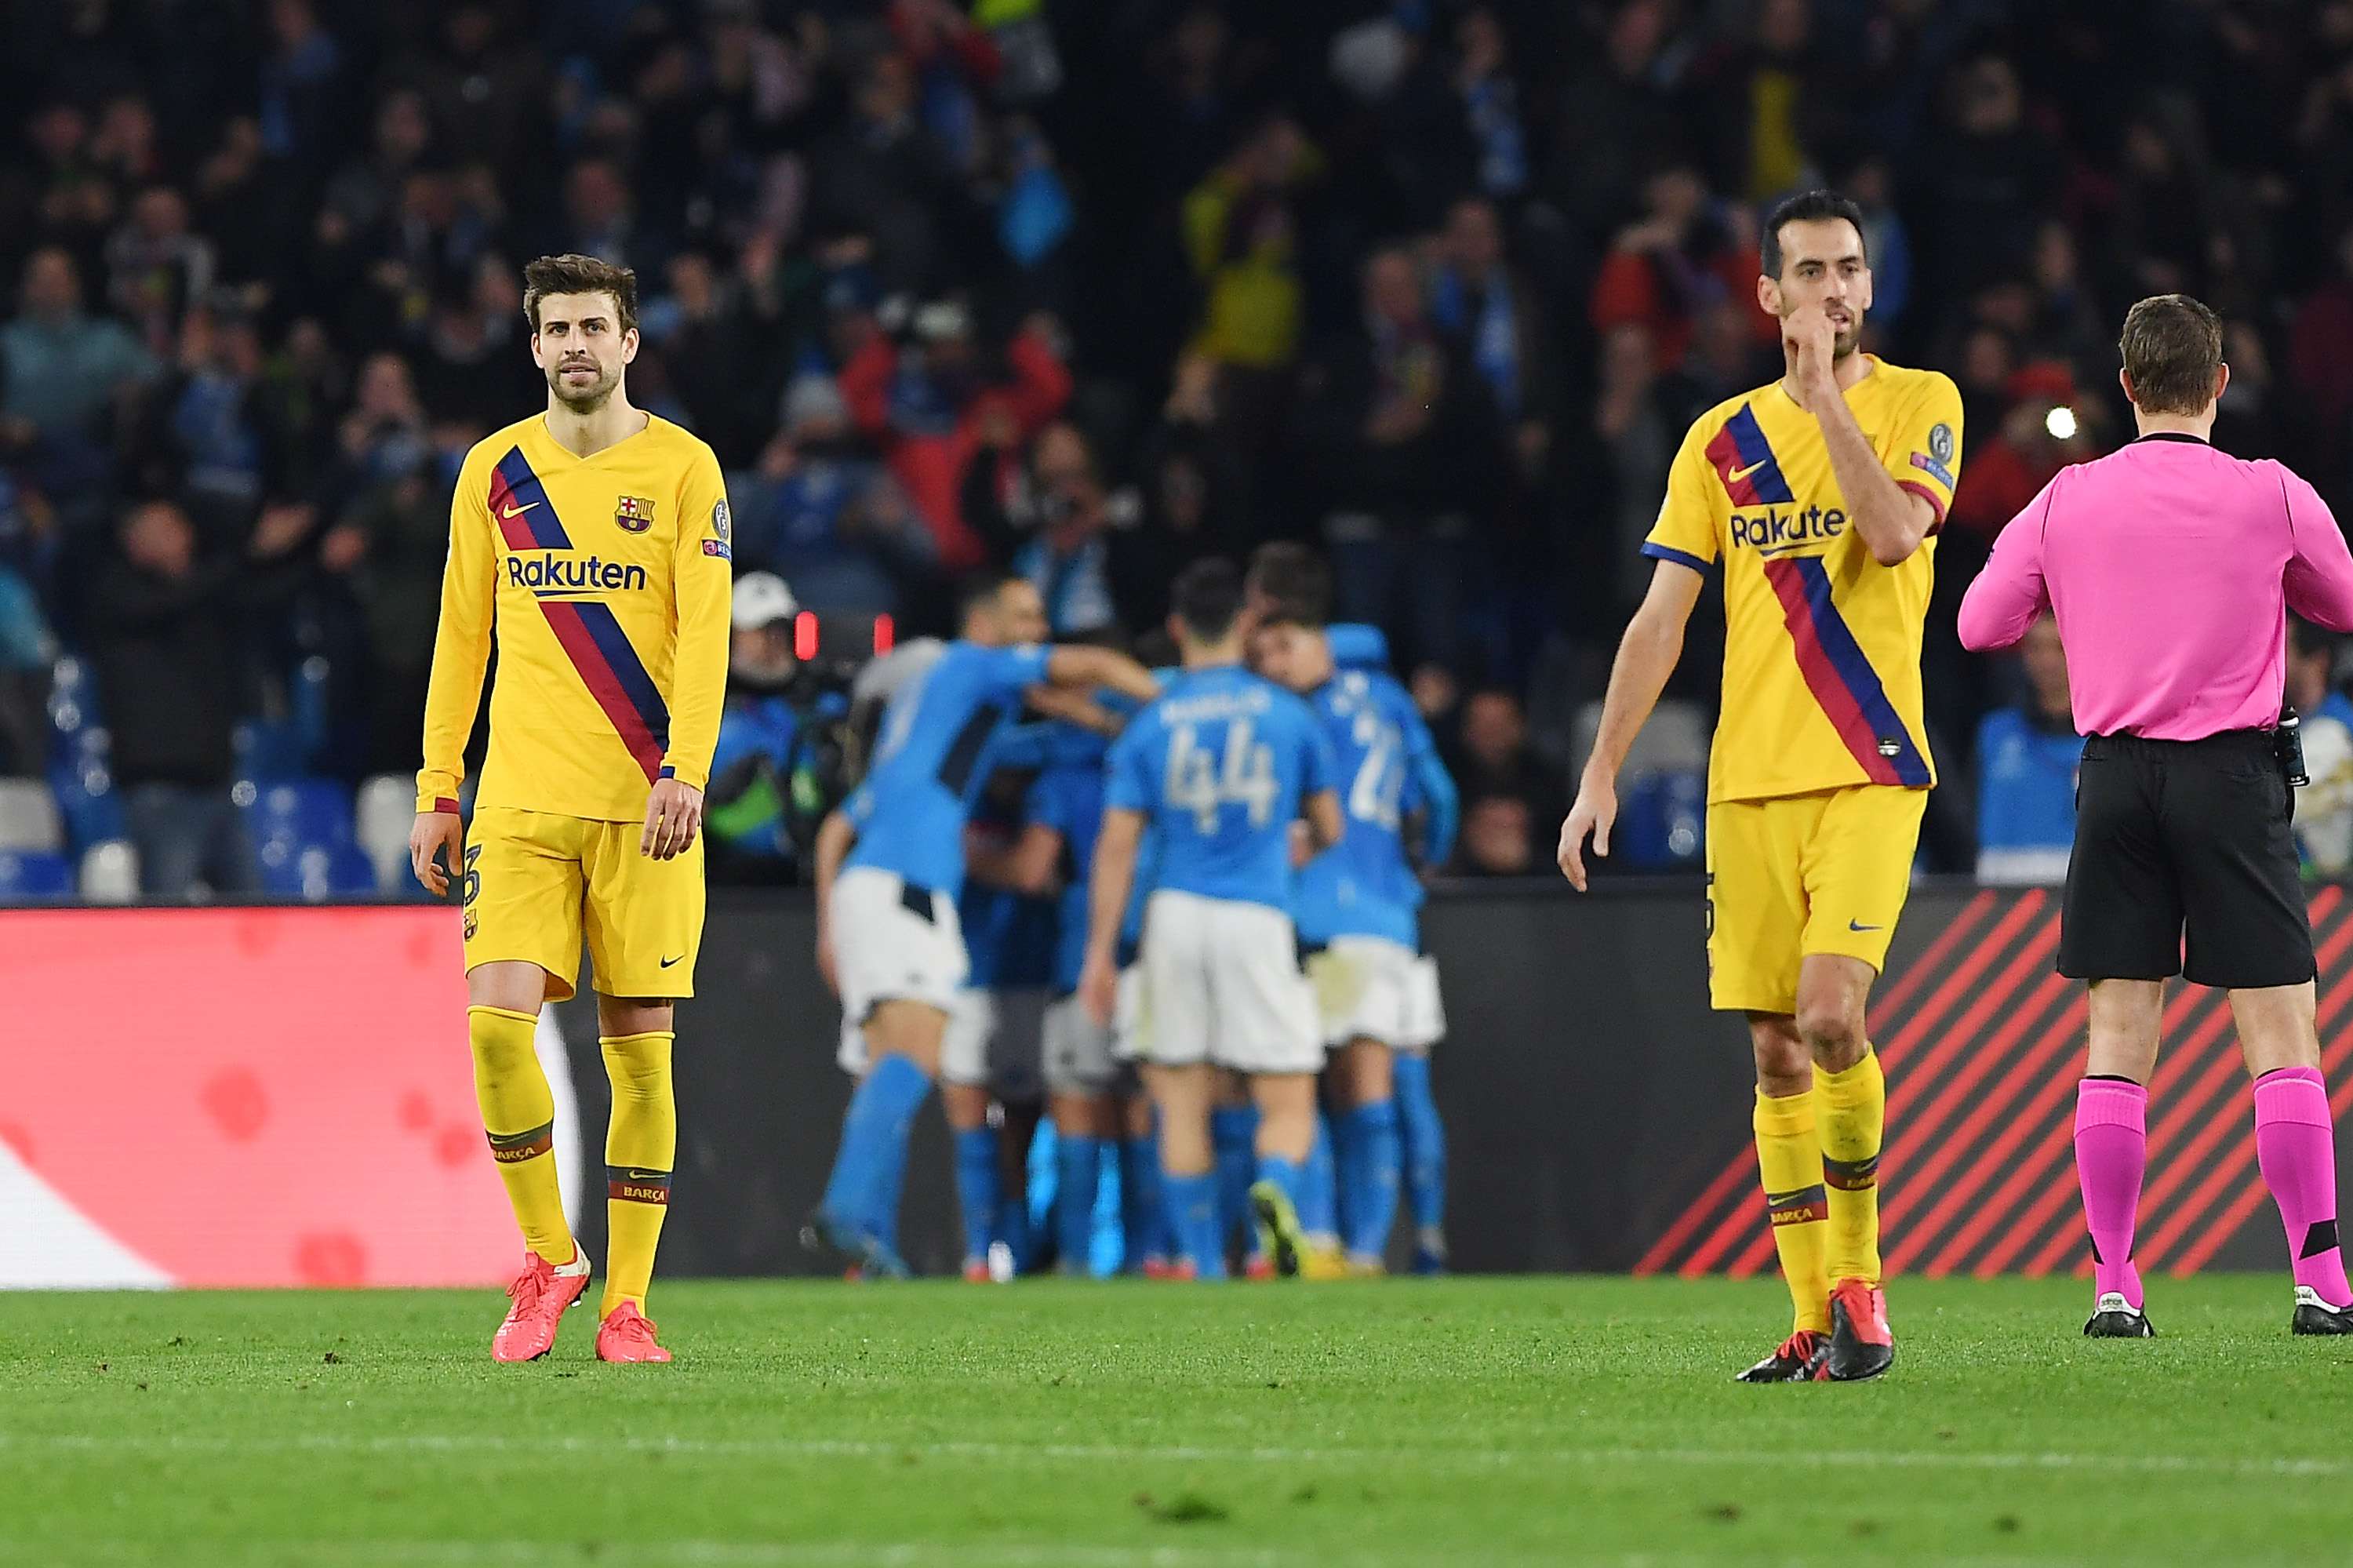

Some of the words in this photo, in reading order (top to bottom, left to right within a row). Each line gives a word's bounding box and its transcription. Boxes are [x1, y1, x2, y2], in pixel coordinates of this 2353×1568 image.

[1731, 504, 1846, 548] Rakute
[507, 552, 646, 590] Rakuten
[1166, 717, 1280, 835] 44
[624, 1185, 665, 1202] BARÇA
